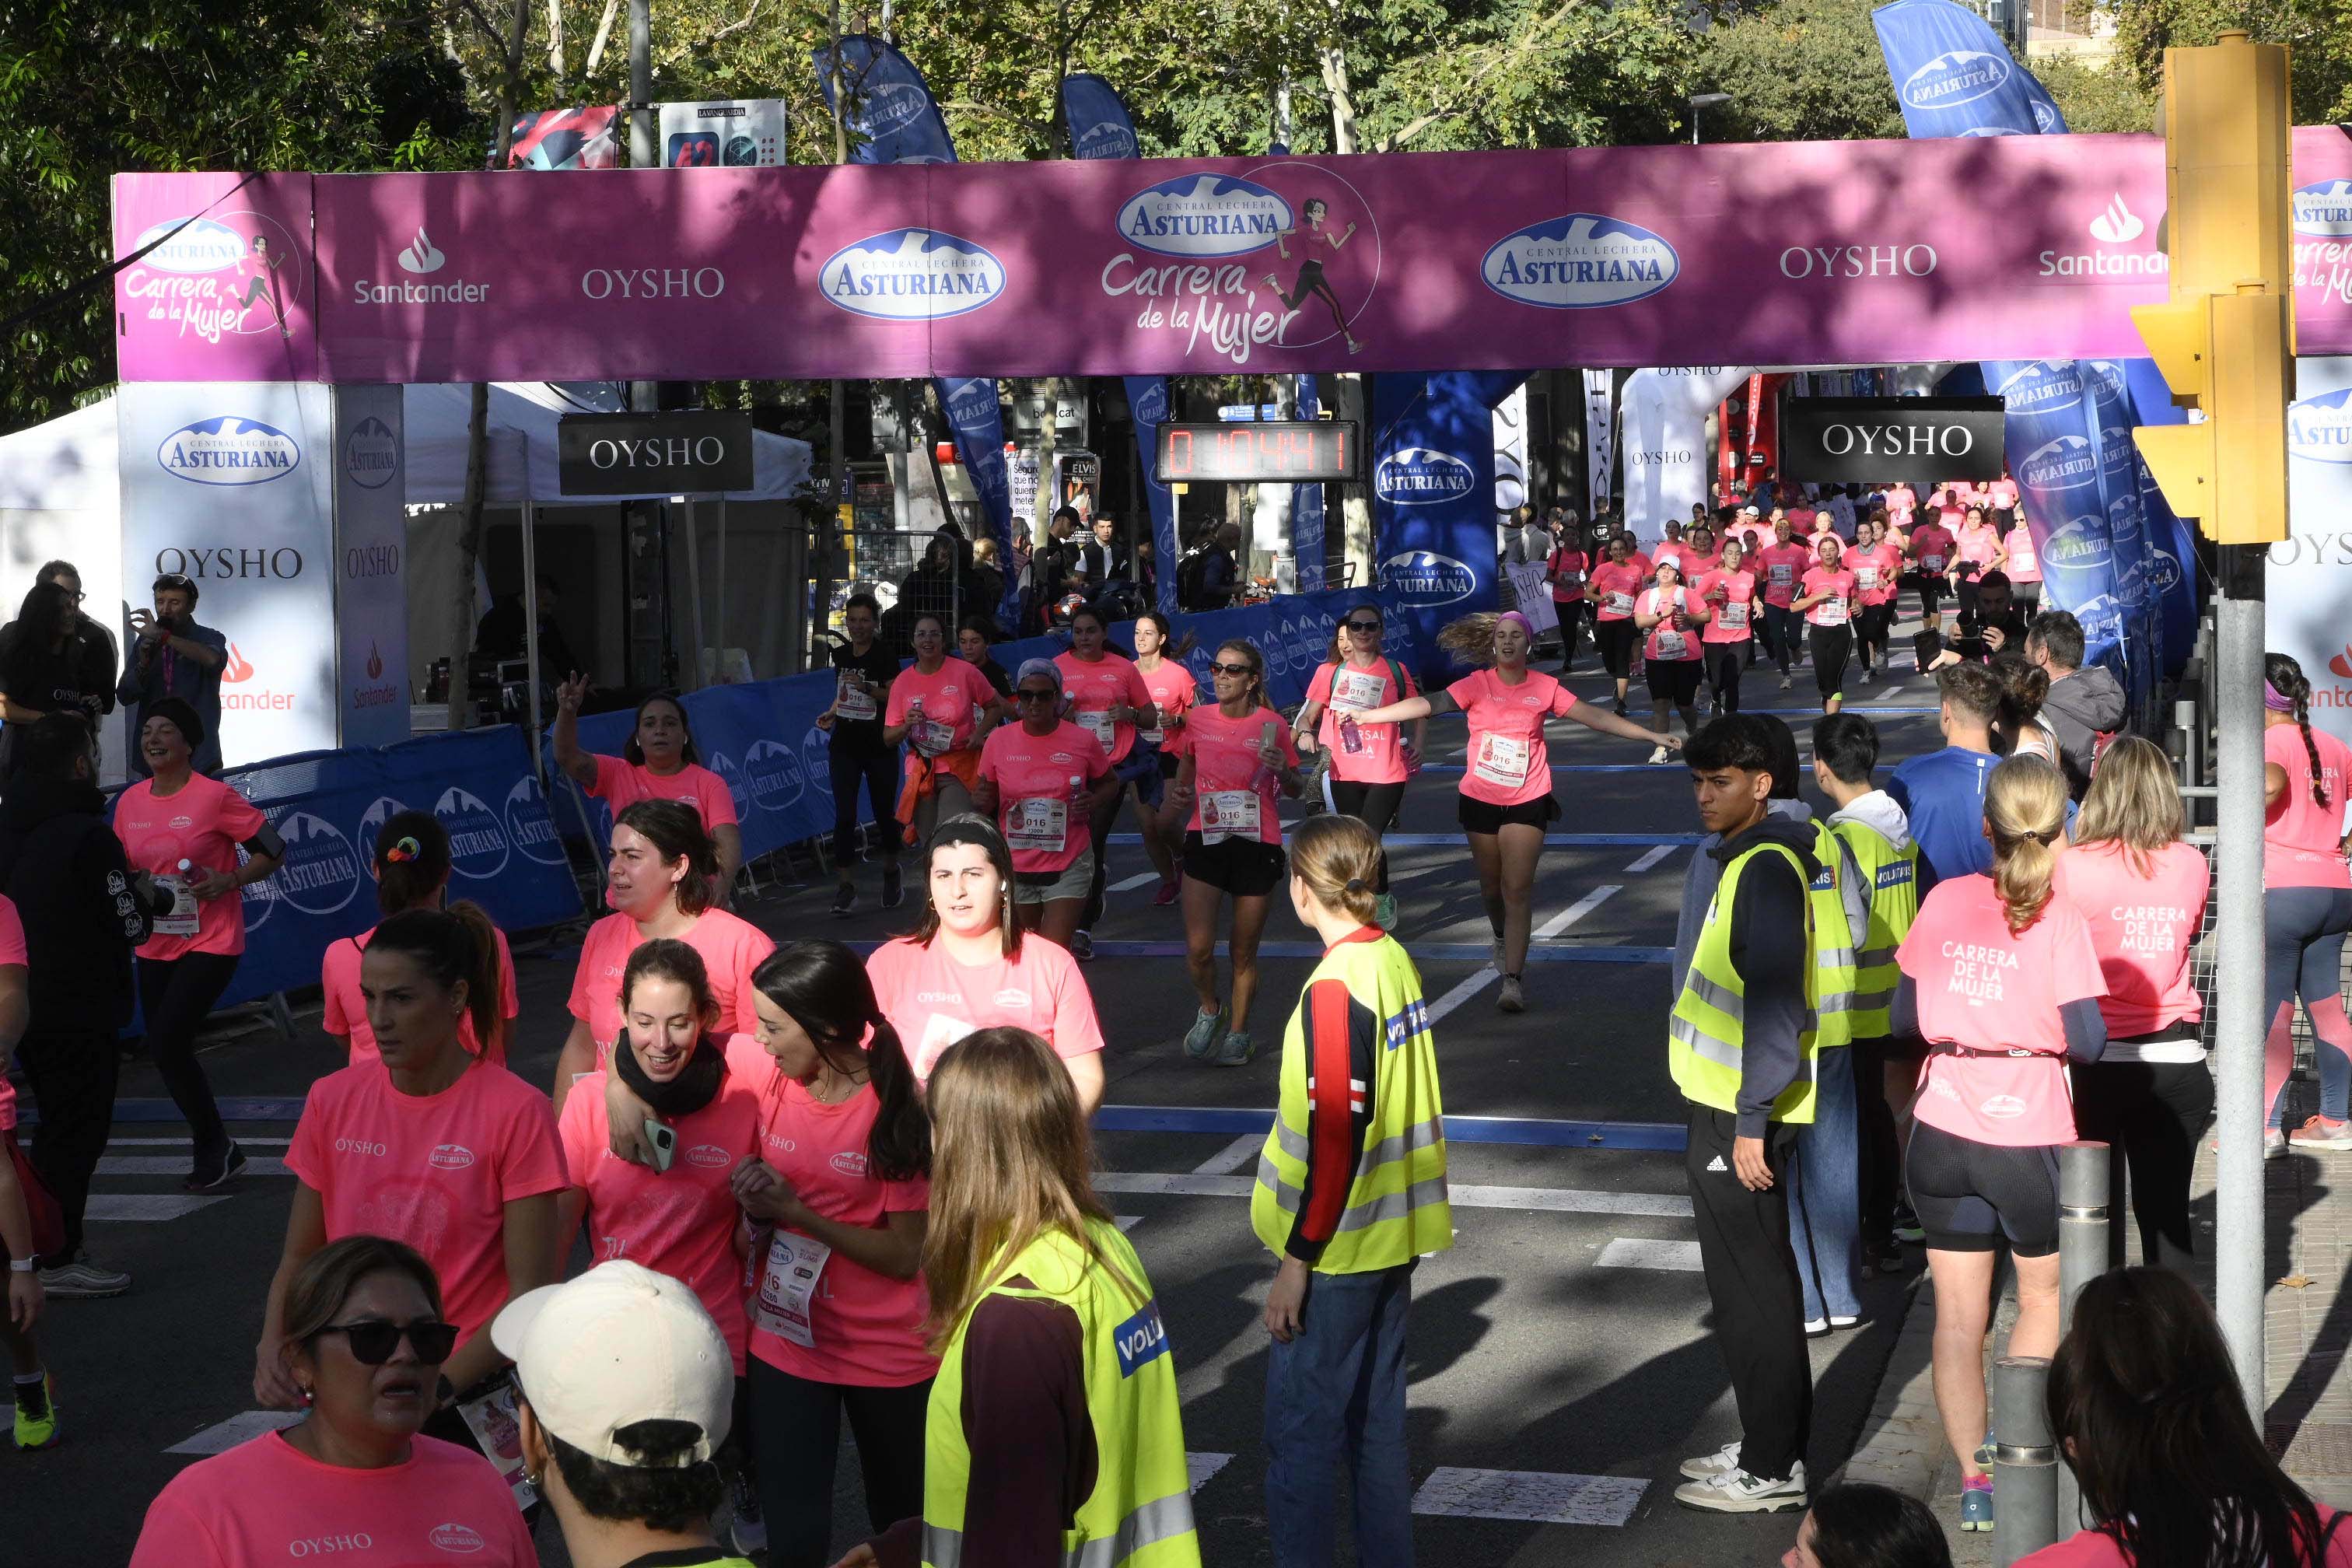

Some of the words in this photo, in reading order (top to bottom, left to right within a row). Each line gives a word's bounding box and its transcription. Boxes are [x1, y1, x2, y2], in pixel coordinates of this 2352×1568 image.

[1157, 201, 1213, 212] CENTRAL
[1218, 199, 1275, 211] LECHERA
[1130, 205, 1279, 237] ASTURIANA
[1526, 247, 1587, 257] CENTRAL
[1594, 245, 1657, 256] LECHERA
[1780, 244, 1938, 278] OYSHO
[862, 259, 922, 269] CENTRAL
[926, 258, 985, 269] LECHERA
[1101, 254, 1247, 296] Carrera
[1496, 250, 1664, 285] ASTURIANA
[124, 269, 218, 299] Carrera
[354, 280, 490, 303] Santander
[582, 268, 725, 299] OYSHO
[833, 263, 992, 297] ASTURIANA
[148, 299, 166, 320] de
[169, 298, 181, 320] la
[180, 296, 253, 344] Mujer
[1137, 299, 1164, 328] de
[1170, 297, 1189, 328] la
[1186, 292, 1301, 364] Mujer
[1822, 425, 1972, 456] OYSHO
[170, 442, 291, 468] ASTURIANA
[349, 443, 394, 472] ASTURIANA
[590, 436, 724, 469] OYSHO
[1632, 450, 1692, 466] OYSHO
[1072, 464, 1097, 474] ELVIS
[1014, 477, 1027, 487] que
[1379, 471, 1467, 492] ASTURIANA
[1015, 506, 1030, 516] este
[156, 548, 303, 579] OYSHO
[347, 544, 399, 579] OYSHO
[354, 684, 398, 709] Santander
[1350, 688, 1366, 697] 016
[1493, 754, 1510, 765] 016
[1026, 818, 1046, 827] 016
[280, 856, 356, 894] ASTURIANA
[2112, 907, 2186, 922] CARRERA
[2126, 921, 2146, 935] DE
[2154, 922, 2172, 935] LA
[1942, 940, 2019, 970] CARRERA
[2120, 936, 2175, 951] MUJER
[1955, 961, 1976, 978] DE
[1983, 966, 2001, 984] LA
[918, 992, 961, 1004] OYSHO
[1948, 978, 2004, 1002] MUJER
[335, 1138, 387, 1157] OYSHO
[688, 1151, 728, 1164] ASTURIANA
[833, 1157, 867, 1172] ASTURIA
[289, 1532, 373, 1558] OYSHO
